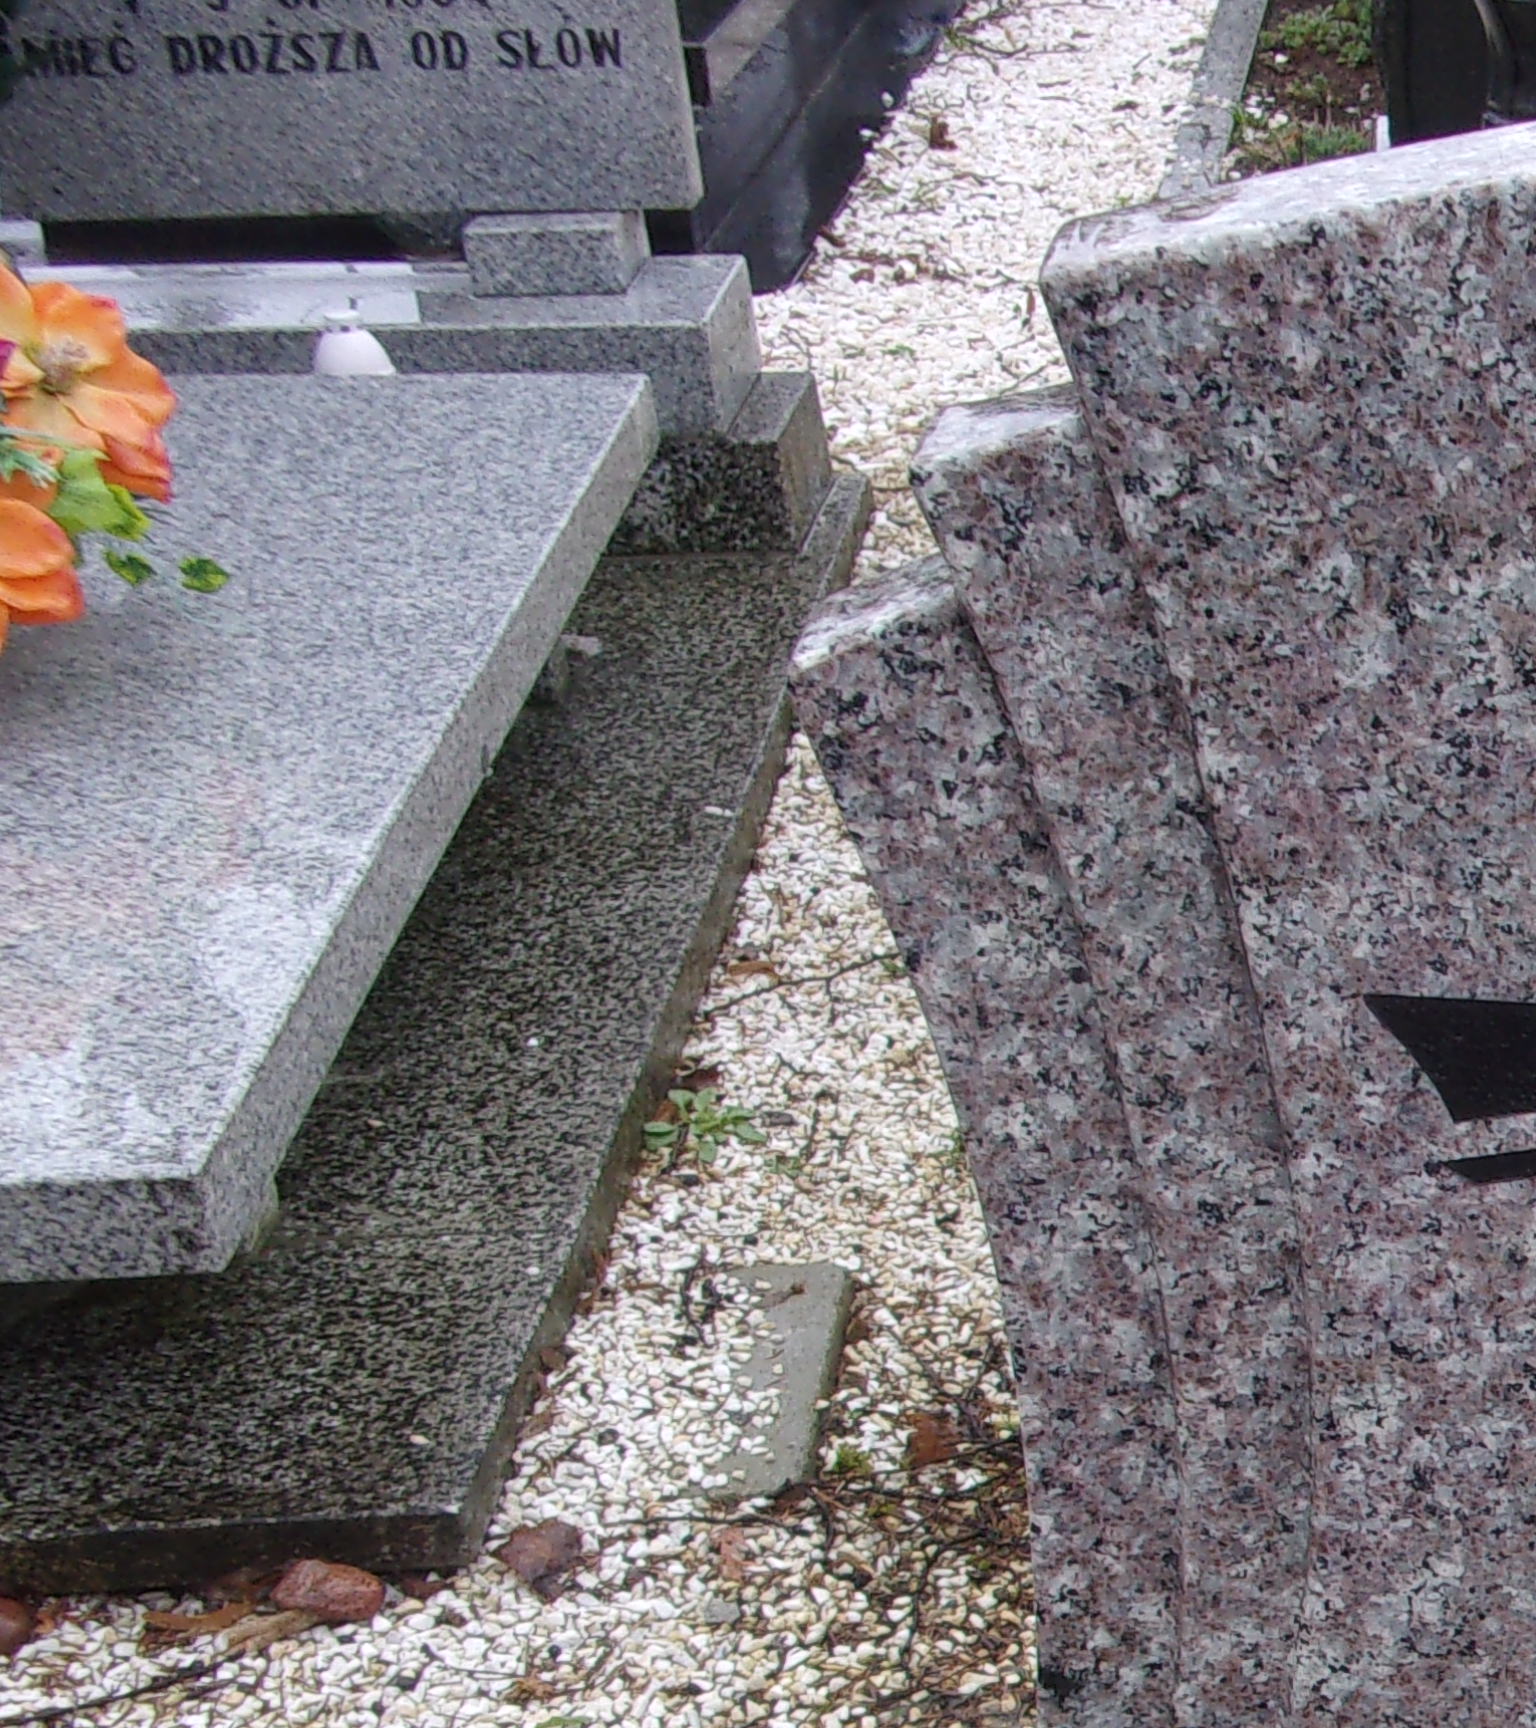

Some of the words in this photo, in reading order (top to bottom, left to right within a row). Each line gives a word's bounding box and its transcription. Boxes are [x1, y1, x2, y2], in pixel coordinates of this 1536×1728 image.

[165, 17, 381, 76] DROŻSZA
[410, 29, 469, 71] OD
[497, 13, 624, 70] SŁÓW
